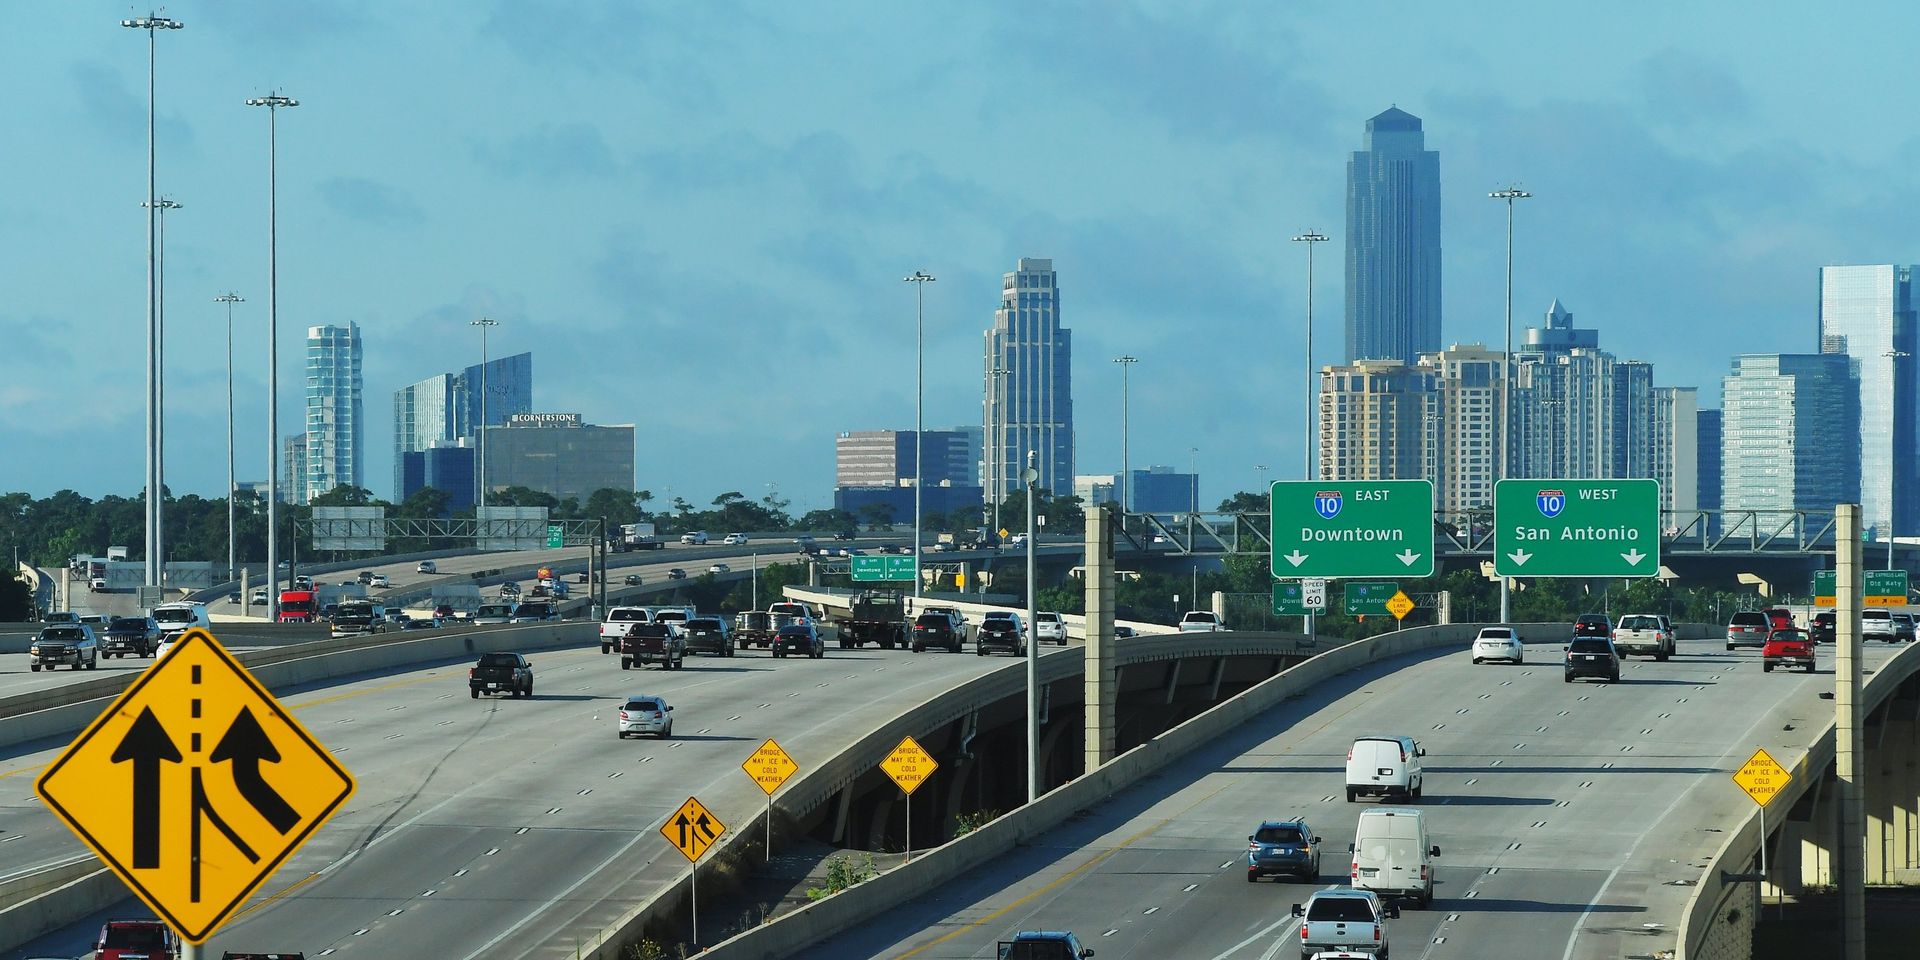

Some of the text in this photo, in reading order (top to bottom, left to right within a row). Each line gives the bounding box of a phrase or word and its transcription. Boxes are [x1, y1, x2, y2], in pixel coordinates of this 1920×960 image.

[519, 414, 576, 422] CORNERSTONE
[1355, 490, 1390, 501] EAST
[1579, 489, 1618, 500] WEST
[1320, 498, 1338, 513] 10
[1542, 496, 1560, 512] 10
[1301, 527, 1403, 542] Downtown
[1515, 525, 1639, 540] San Antonio
[1306, 596, 1322, 605] 60
[899, 747, 919, 755] BRIDGE
[901, 765, 916, 773] COLD
[896, 774, 922, 782] WEATHER
